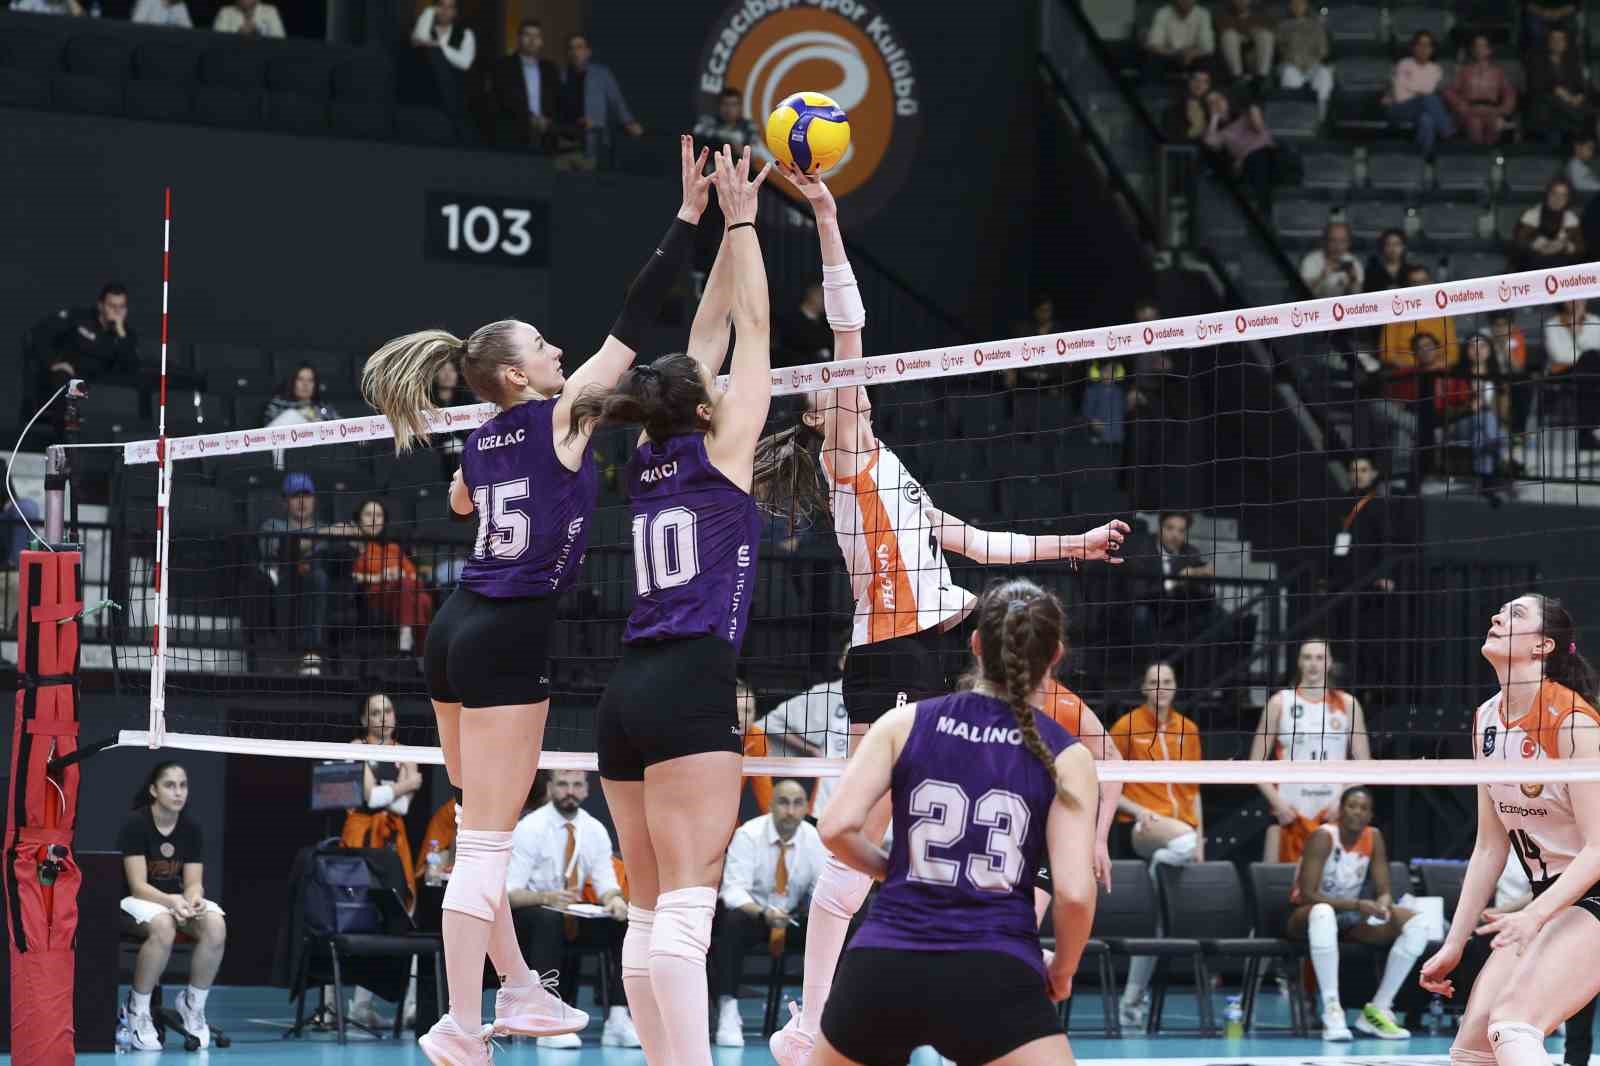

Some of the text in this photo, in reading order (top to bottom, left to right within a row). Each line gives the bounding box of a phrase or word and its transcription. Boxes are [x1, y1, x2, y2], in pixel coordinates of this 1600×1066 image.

[701, 0, 799, 93] Eczacıba
[865, 16, 918, 115] Kulübü
[441, 204, 531, 255] 103
[800, 374, 813, 383] TVF
[830, 369, 855, 378] vodafone
[873, 366, 887, 375] TVF
[906, 359, 931, 369] vodafone
[950, 357, 965, 366] TVF
[984, 350, 1011, 361] vodafone
[1032, 346, 1045, 356] TVF
[1067, 339, 1095, 350] vodafone
[1117, 335, 1132, 346] TVF
[1154, 328, 1184, 340] vodafone
[1208, 324, 1223, 335] TVF
[1247, 315, 1279, 328] vodafone
[1304, 311, 1320, 323] TVF
[1345, 303, 1378, 315] vodafone
[1405, 299, 1422, 312] TVF
[1449, 289, 1484, 303] vodafone
[1512, 284, 1531, 297] TVF
[1560, 273, 1597, 289] vodafone
[477, 428, 526, 451] UZELAC
[472, 477, 531, 560] 15
[631, 506, 701, 598] 10
[935, 716, 1024, 746] MALINO
[906, 778, 1032, 894] 23
